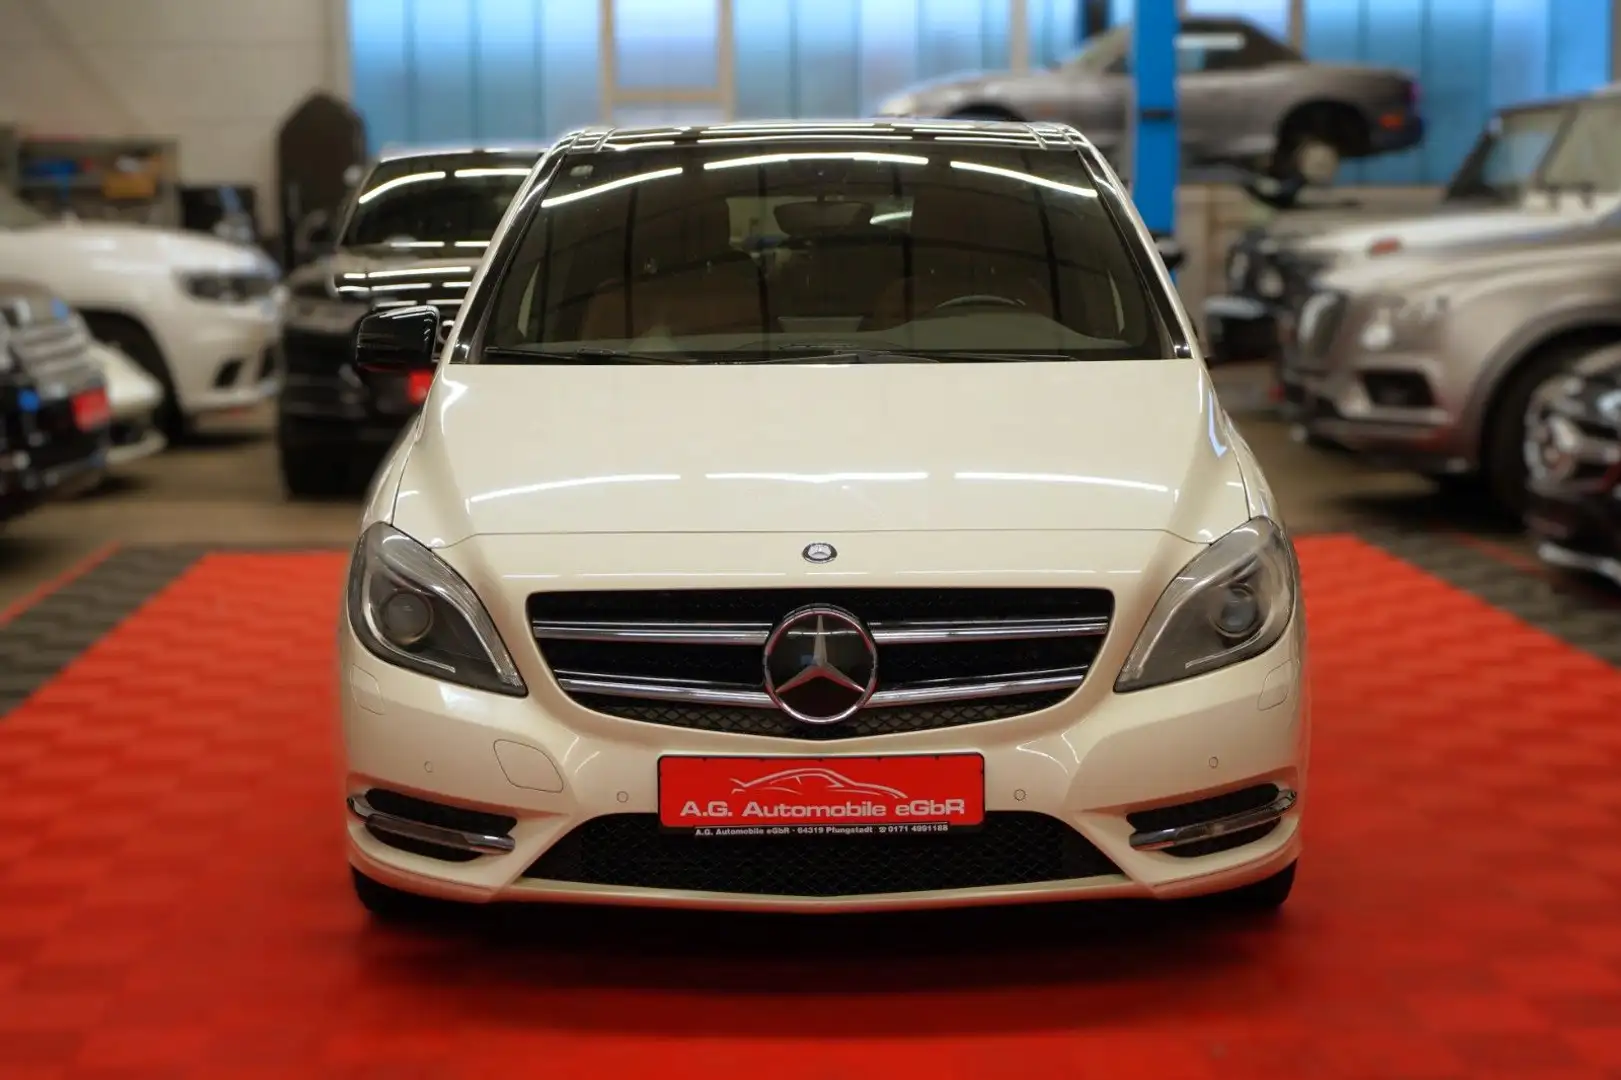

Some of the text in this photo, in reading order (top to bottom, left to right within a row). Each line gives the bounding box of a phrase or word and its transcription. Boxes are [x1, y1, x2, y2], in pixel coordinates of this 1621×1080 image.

[680, 798, 965, 818] A.G. Automobile eGbR
[695, 828, 714, 836] A.G.
[715, 827, 764, 835] Automobile
[766, 827, 790, 835] eGbR
[826, 825, 873, 835] Pfungstadt
[887, 825, 909, 833] 0171
